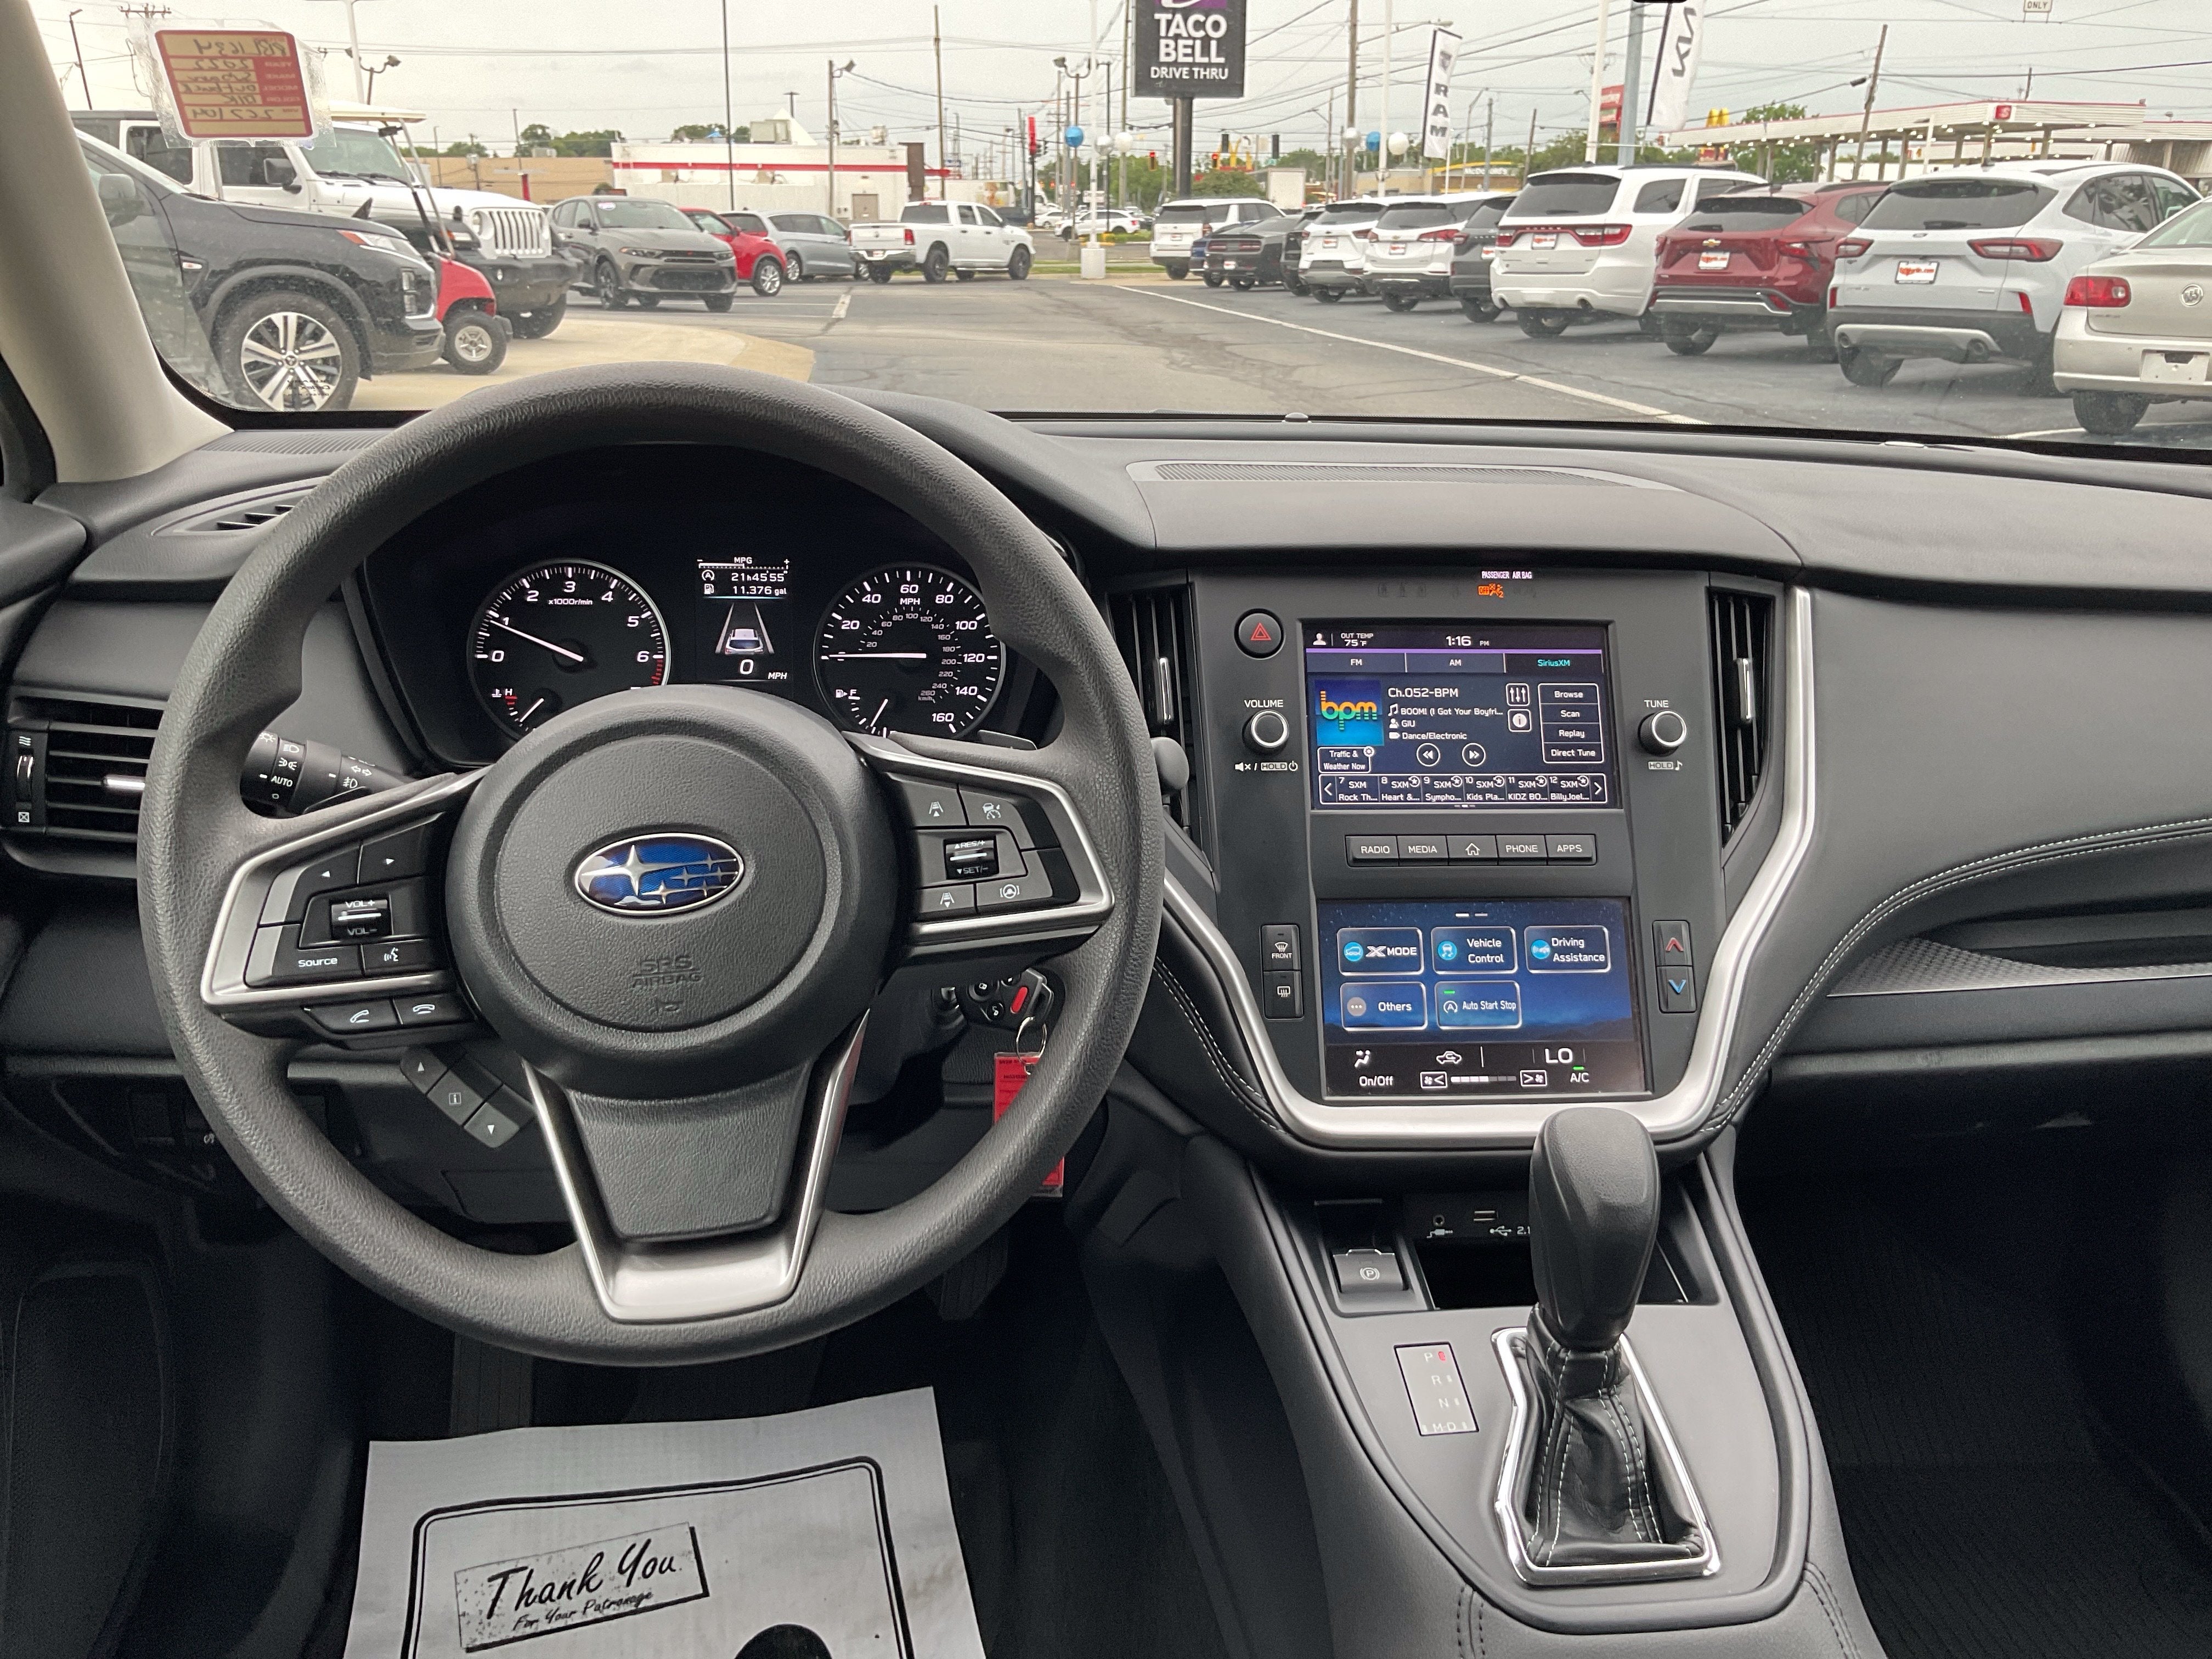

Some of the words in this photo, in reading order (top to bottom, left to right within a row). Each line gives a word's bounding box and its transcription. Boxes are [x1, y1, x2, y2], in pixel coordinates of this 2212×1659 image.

[1154, 14, 1227, 38] TACO
[1159, 38, 1225, 63] BELL
[1150, 66, 1190, 78] DRIVE
[1192, 67, 1229, 80] THRU
[1430, 83, 1449, 137] RAM
[564, 582, 576, 592] 3
[733, 585, 772, 594] 11.376
[900, 584, 919, 594] 60
[527, 590, 539, 602] 2
[601, 591, 613, 602] 4
[862, 594, 881, 603] 40
[935, 594, 953, 604] 80
[503, 617, 509, 625] 1
[627, 616, 639, 627] 5
[841, 620, 860, 630] 20
[955, 621, 978, 630] 100
[1446, 636, 1471, 646] 1:16
[492, 651, 504, 662] 0
[637, 651, 650, 662] 6
[963, 653, 985, 662] 120
[740, 659, 754, 674] 0
[955, 686, 978, 696] 140
[1388, 687, 1459, 697] Ch.052-BPM
[1554, 690, 1583, 698] Browse
[1244, 699, 1284, 708] VOLUME
[1320, 690, 1377, 730] bpm
[932, 713, 954, 722] 160
[1559, 730, 1585, 738] Replay
[271, 775, 293, 787] AUTO
[1425, 794, 1462, 802] Sympho...
[1361, 845, 1390, 854] RADIO
[1408, 845, 1437, 854] MEDIA
[1505, 845, 1538, 853] PHONE
[1556, 844, 1582, 853] APPS
[1467, 938, 1502, 947] Vehicle
[1551, 938, 1584, 949] Driving
[298, 957, 338, 967] Source
[1468, 953, 1504, 963] Control
[1553, 953, 1605, 962] Assistance
[1378, 1002, 1412, 1011] Others
[1462, 1001, 1479, 1010] Auto
[1480, 1000, 1498, 1009] Start
[1500, 1000, 1516, 1011] Stop
[1545, 1048, 1573, 1064] LO
[1359, 1075, 1393, 1087] On/Off
[1570, 1072, 1589, 1083] A/C
[1424, 1352, 1432, 1362] P
[1431, 1375, 1442, 1385] R
[1438, 1398, 1449, 1408] N
[487, 1551, 604, 1620] Thank
[618, 1538, 677, 1588] You
[513, 1616, 538, 1631] For
[546, 1607, 577, 1624] Your
[583, 1591, 653, 1615] Patronage
